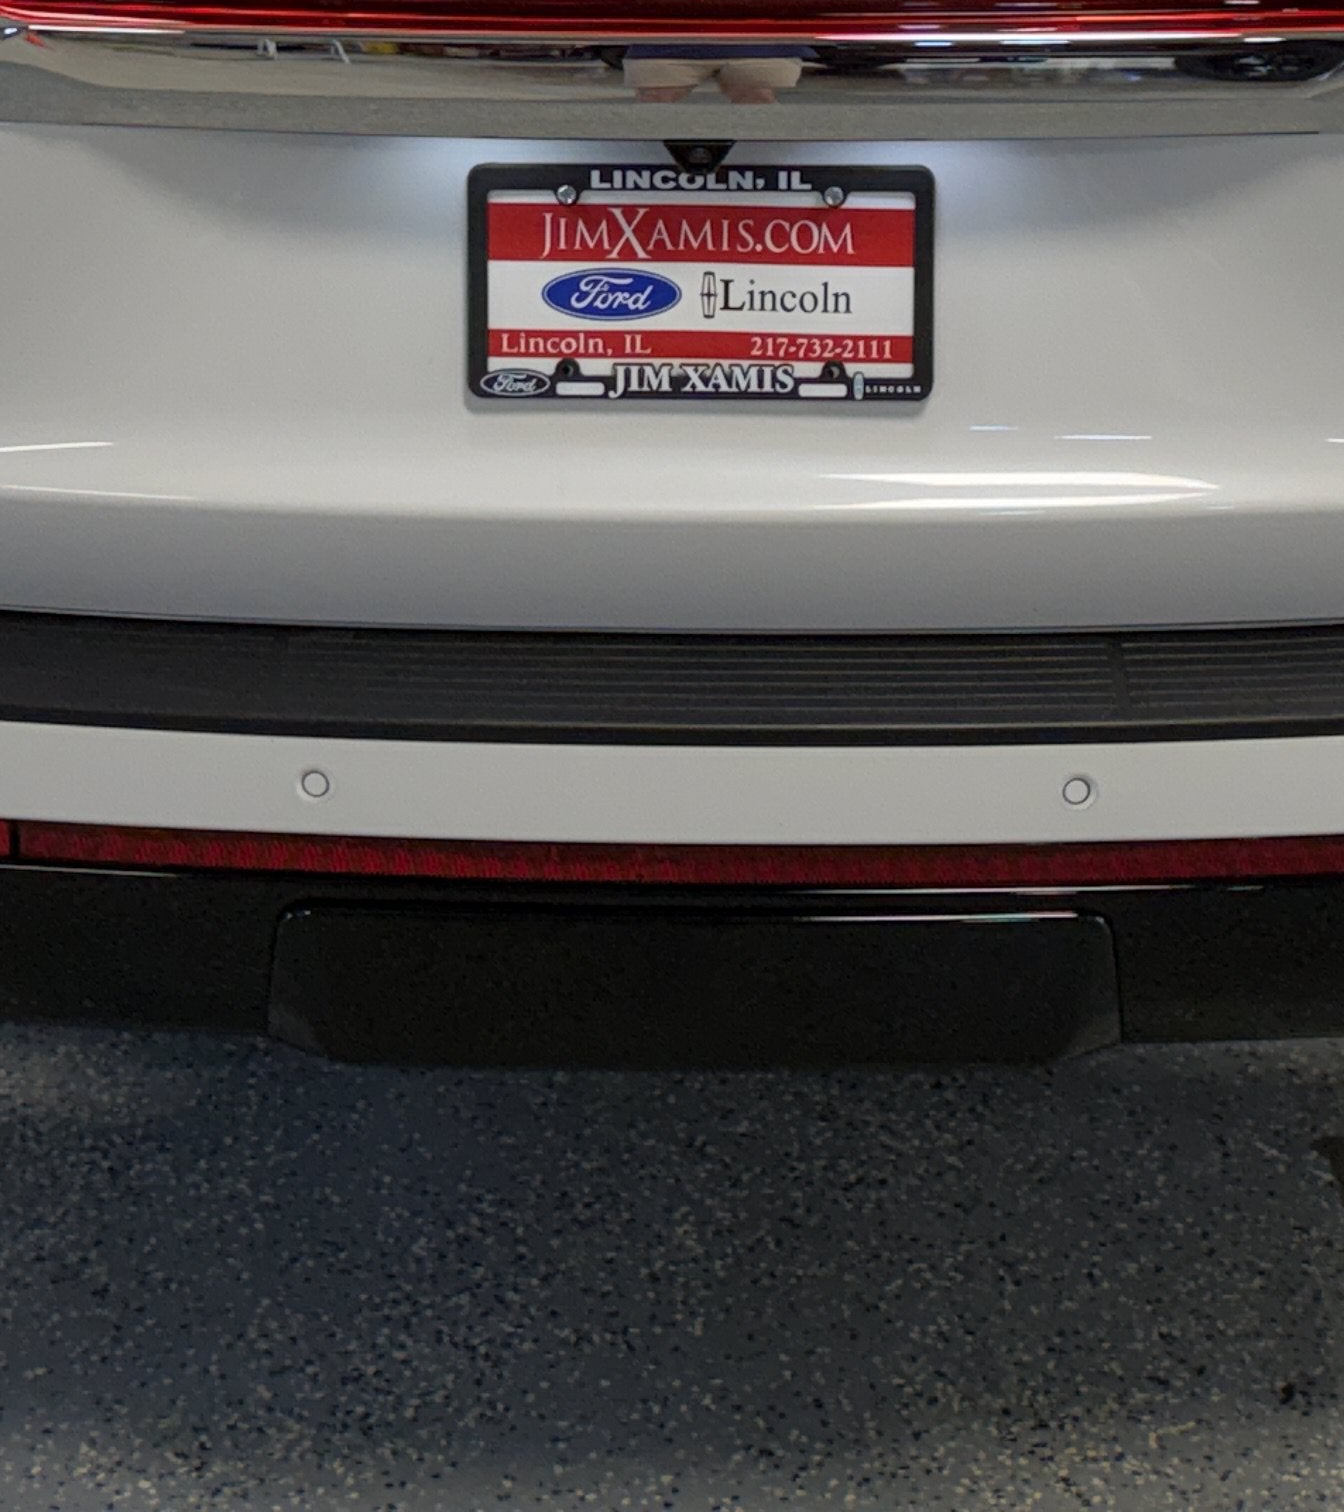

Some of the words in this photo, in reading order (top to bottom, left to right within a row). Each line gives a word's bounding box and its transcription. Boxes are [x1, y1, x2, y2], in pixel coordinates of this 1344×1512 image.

[590, 170, 765, 190] LINCOLN,
[778, 170, 813, 190] IL
[540, 206, 855, 260] JIMXAMIS.COM
[570, 276, 652, 312] Ford
[720, 279, 853, 314] Lincoln
[501, 332, 613, 356] Lincoln,
[624, 334, 652, 354] IL
[750, 336, 893, 359] 217-732-2111
[492, 373, 537, 393] Ford
[608, 363, 673, 399] JIM
[683, 364, 795, 395] XAMIS
